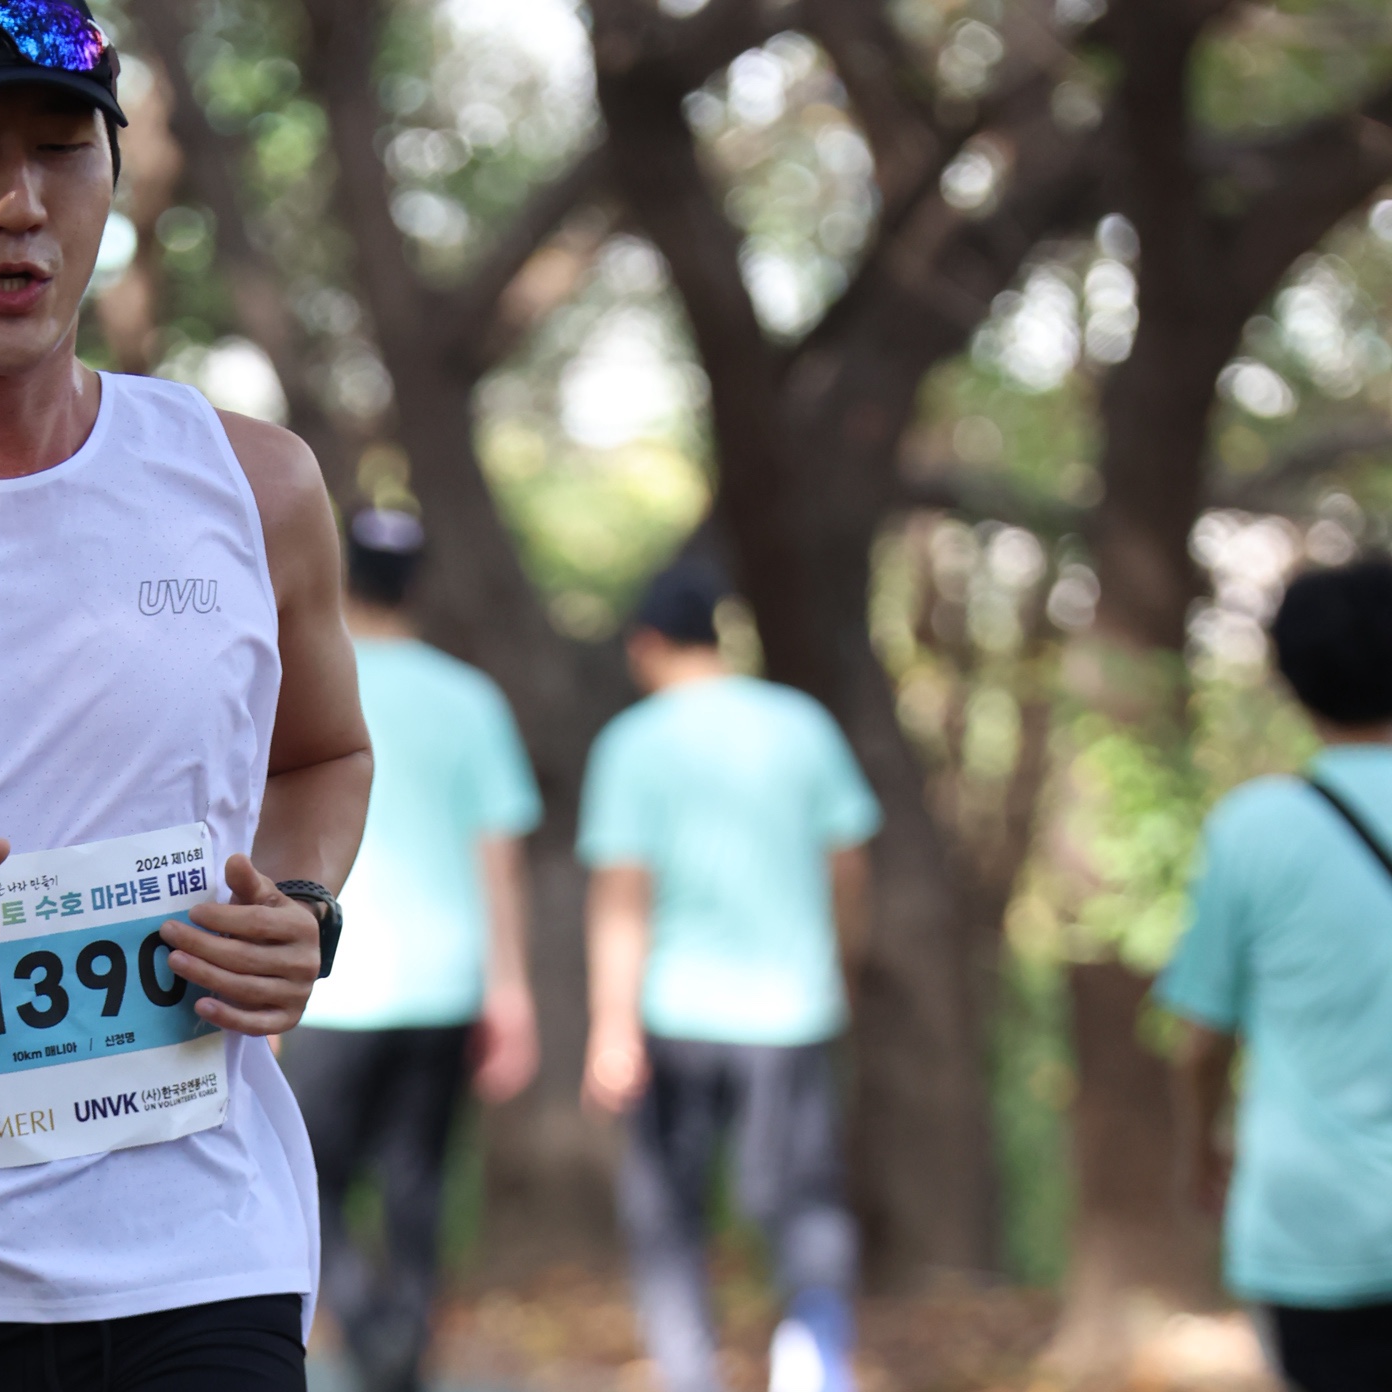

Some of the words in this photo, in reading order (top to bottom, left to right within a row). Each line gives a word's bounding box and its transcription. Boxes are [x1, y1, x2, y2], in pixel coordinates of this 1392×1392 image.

[135, 855, 168, 872] 2024
[171, 847, 203, 865] 제16회
[30, 874, 59, 891] 만들기
[35, 891, 84, 920] 수호
[91, 876, 161, 911] 마라톤
[167, 866, 207, 897] 대회
[12, 1050, 43, 1063] 10km
[44, 1042, 78, 1057] 매니아
[74, 1091, 139, 1123] UNVK
[144, 1103, 157, 1112] UN
